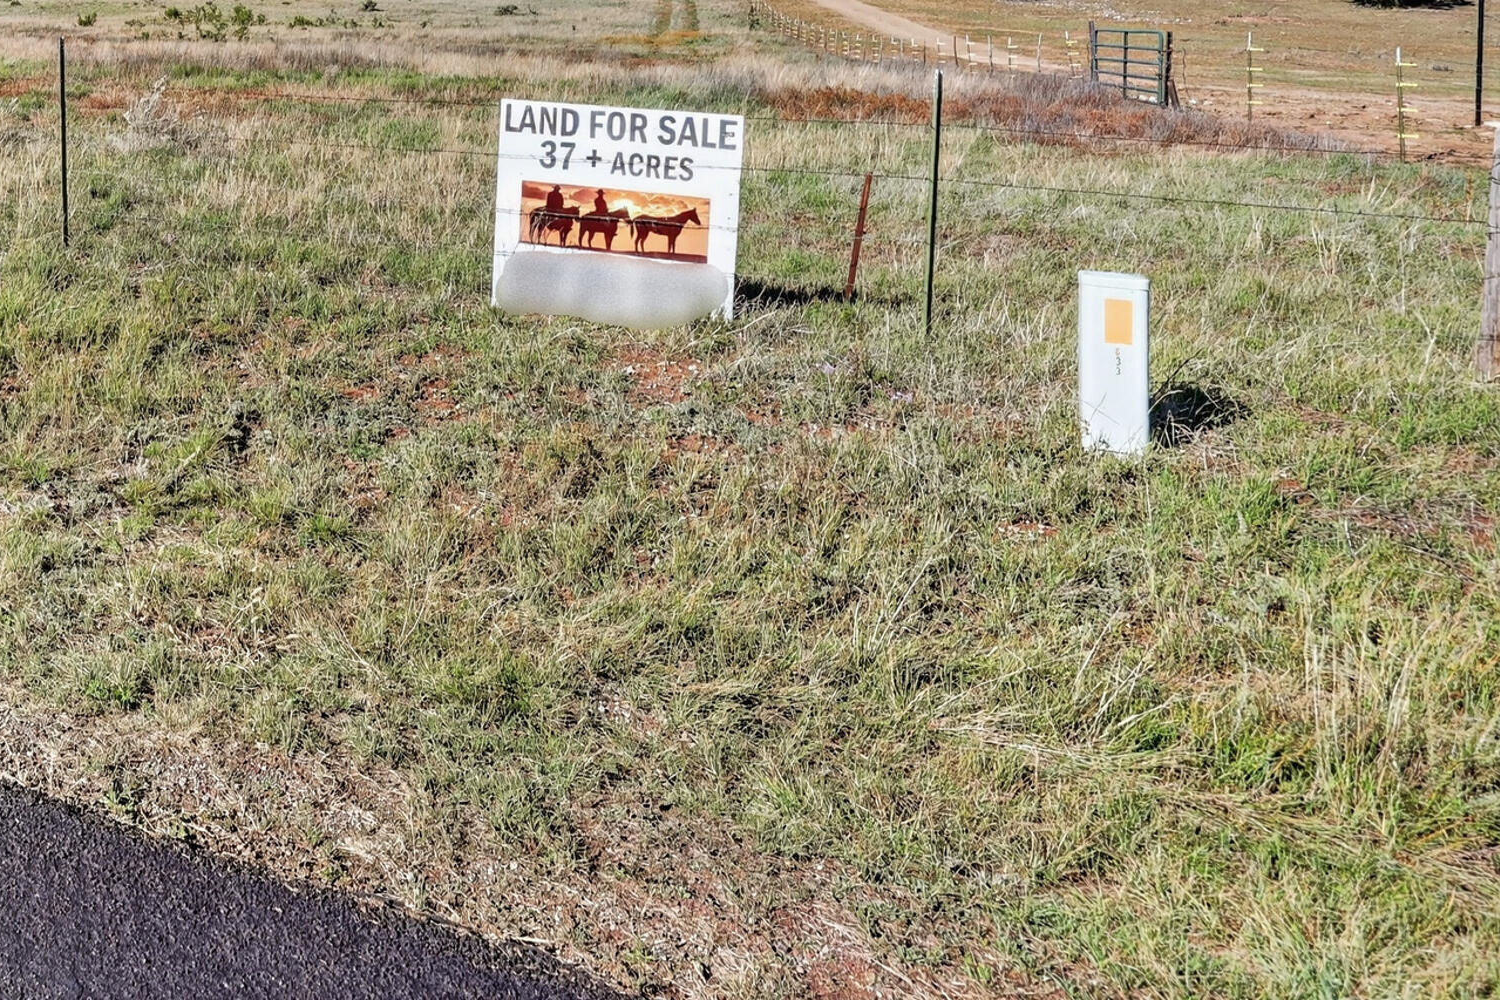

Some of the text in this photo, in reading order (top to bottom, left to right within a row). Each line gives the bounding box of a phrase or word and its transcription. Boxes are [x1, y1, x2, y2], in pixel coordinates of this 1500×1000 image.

[504, 103, 739, 151] LAND FOR SALE
[538, 140, 695, 182] 37 + ACRES
